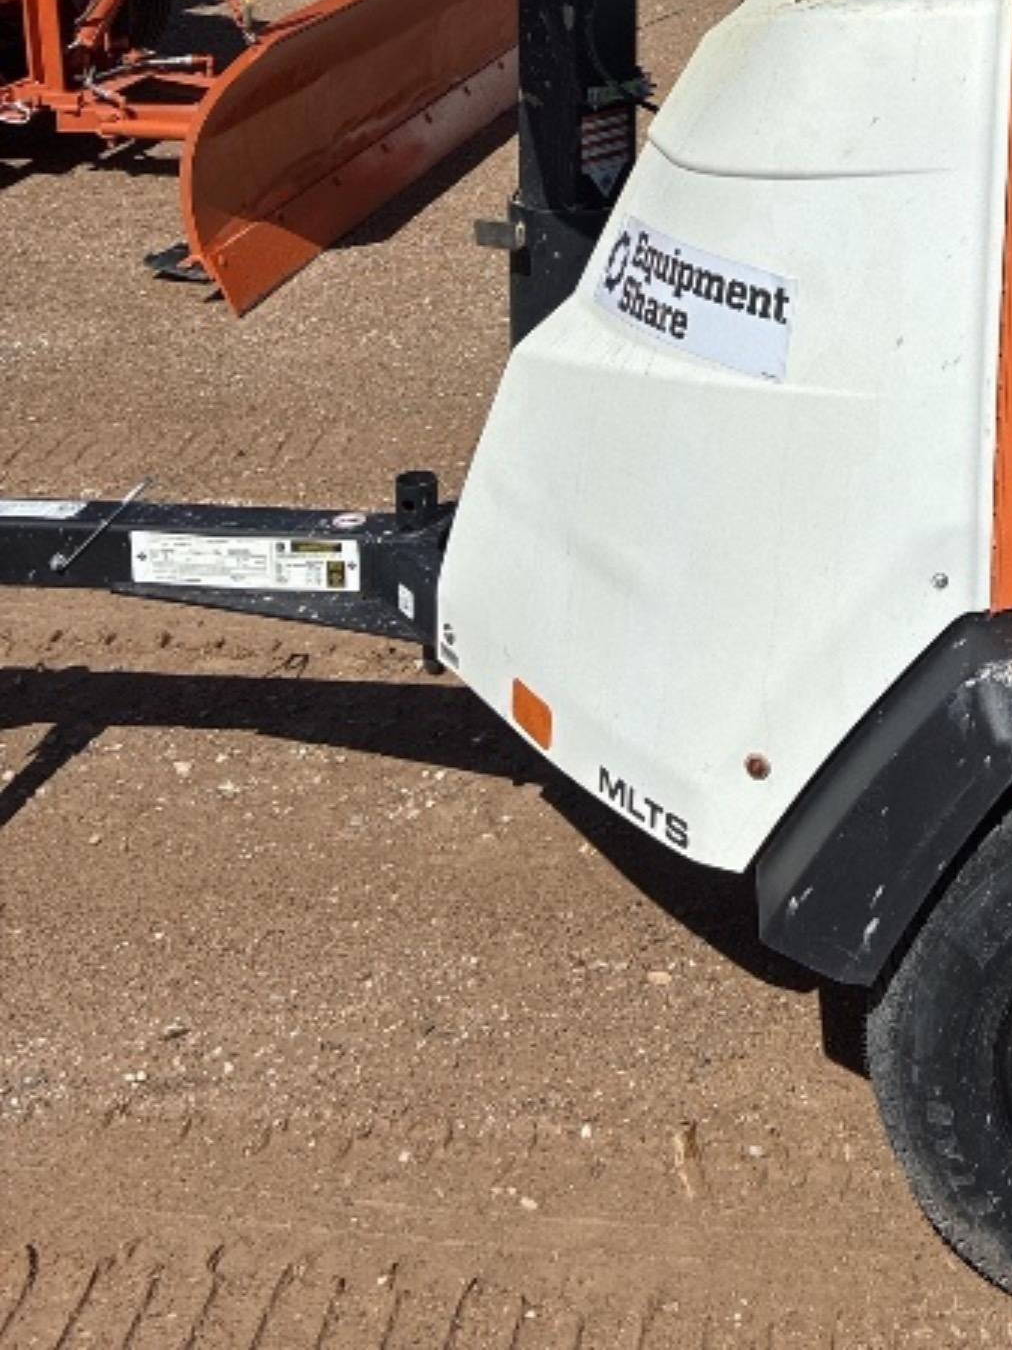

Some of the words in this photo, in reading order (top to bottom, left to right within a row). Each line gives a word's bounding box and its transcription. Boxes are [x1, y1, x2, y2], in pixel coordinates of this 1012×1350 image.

[617, 275, 689, 340] Share
[631, 229, 791, 325] Equipment
[599, 764, 690, 850] MLTS
